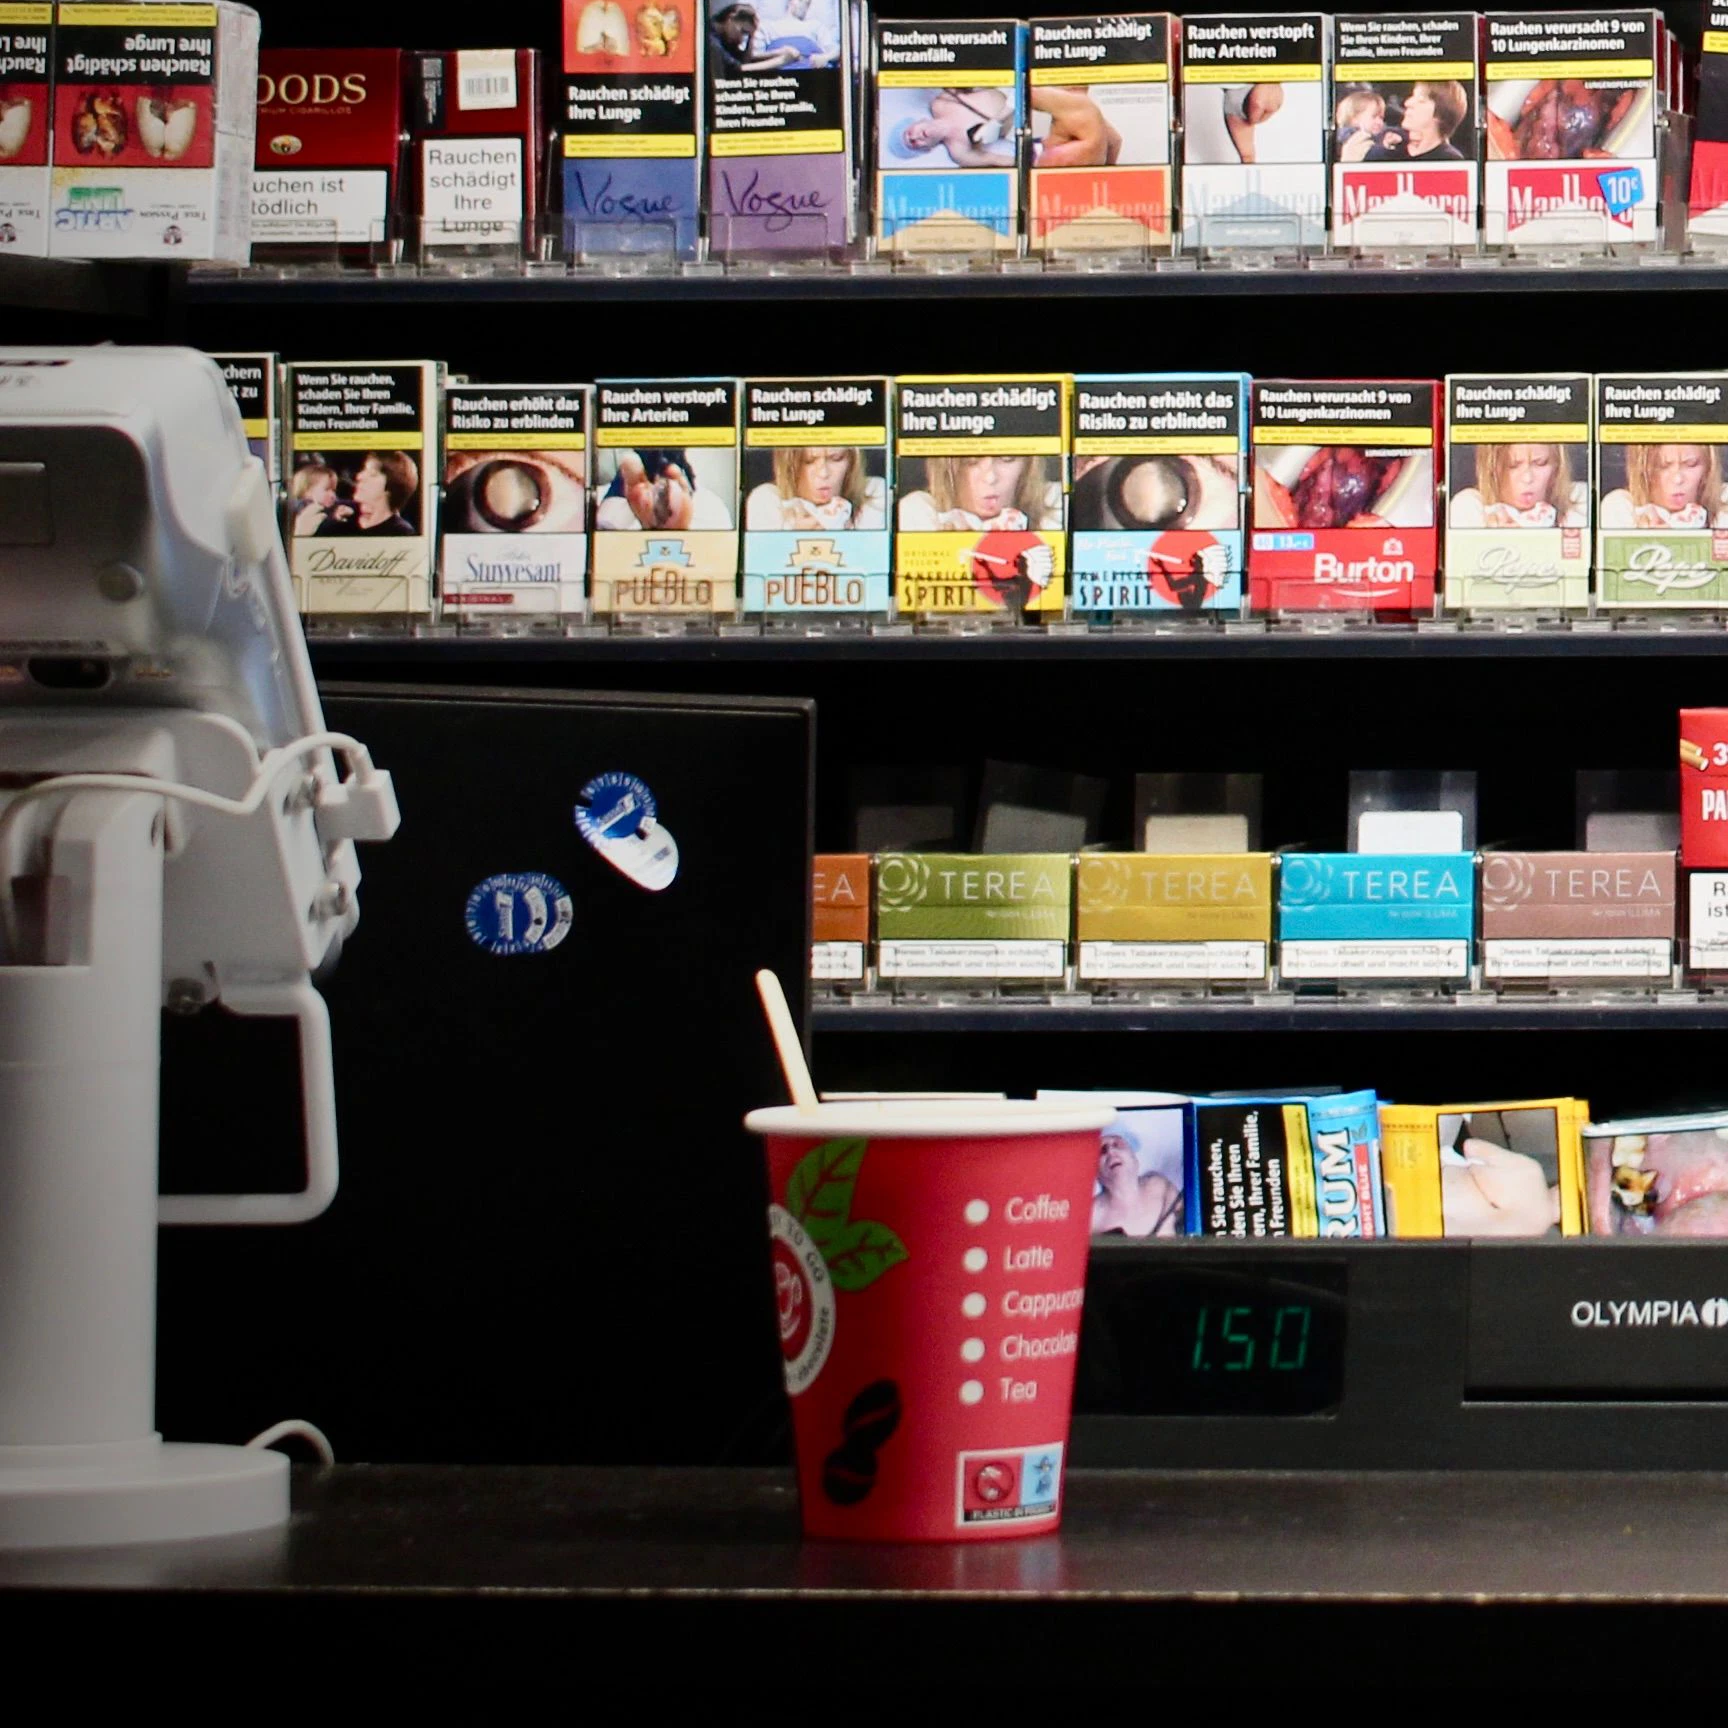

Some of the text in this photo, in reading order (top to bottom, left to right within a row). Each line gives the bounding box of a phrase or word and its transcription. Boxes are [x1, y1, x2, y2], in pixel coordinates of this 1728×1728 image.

[257, 73, 367, 106] OODS
[429, 148, 517, 166] Rauchen
[430, 171, 516, 192] schädigt
[454, 194, 492, 211] Ihre
[721, 171, 833, 233] Vogue
[442, 216, 503, 235] Lunge
[308, 548, 409, 576] Davidoff
[1314, 552, 1414, 584] Burton
[765, 568, 864, 606] PUEBLO
[904, 586, 978, 607] SPIRIT
[940, 871, 1054, 900] TEREA
[1344, 870, 1460, 899] TEREA
[1546, 869, 1661, 898] TEREA
[1005, 1196, 1069, 1222] Coffee
[1003, 1246, 1054, 1270] Latte
[1571, 1300, 1699, 1327] OLYMPIA
[1000, 1378, 1037, 1402] Tea
